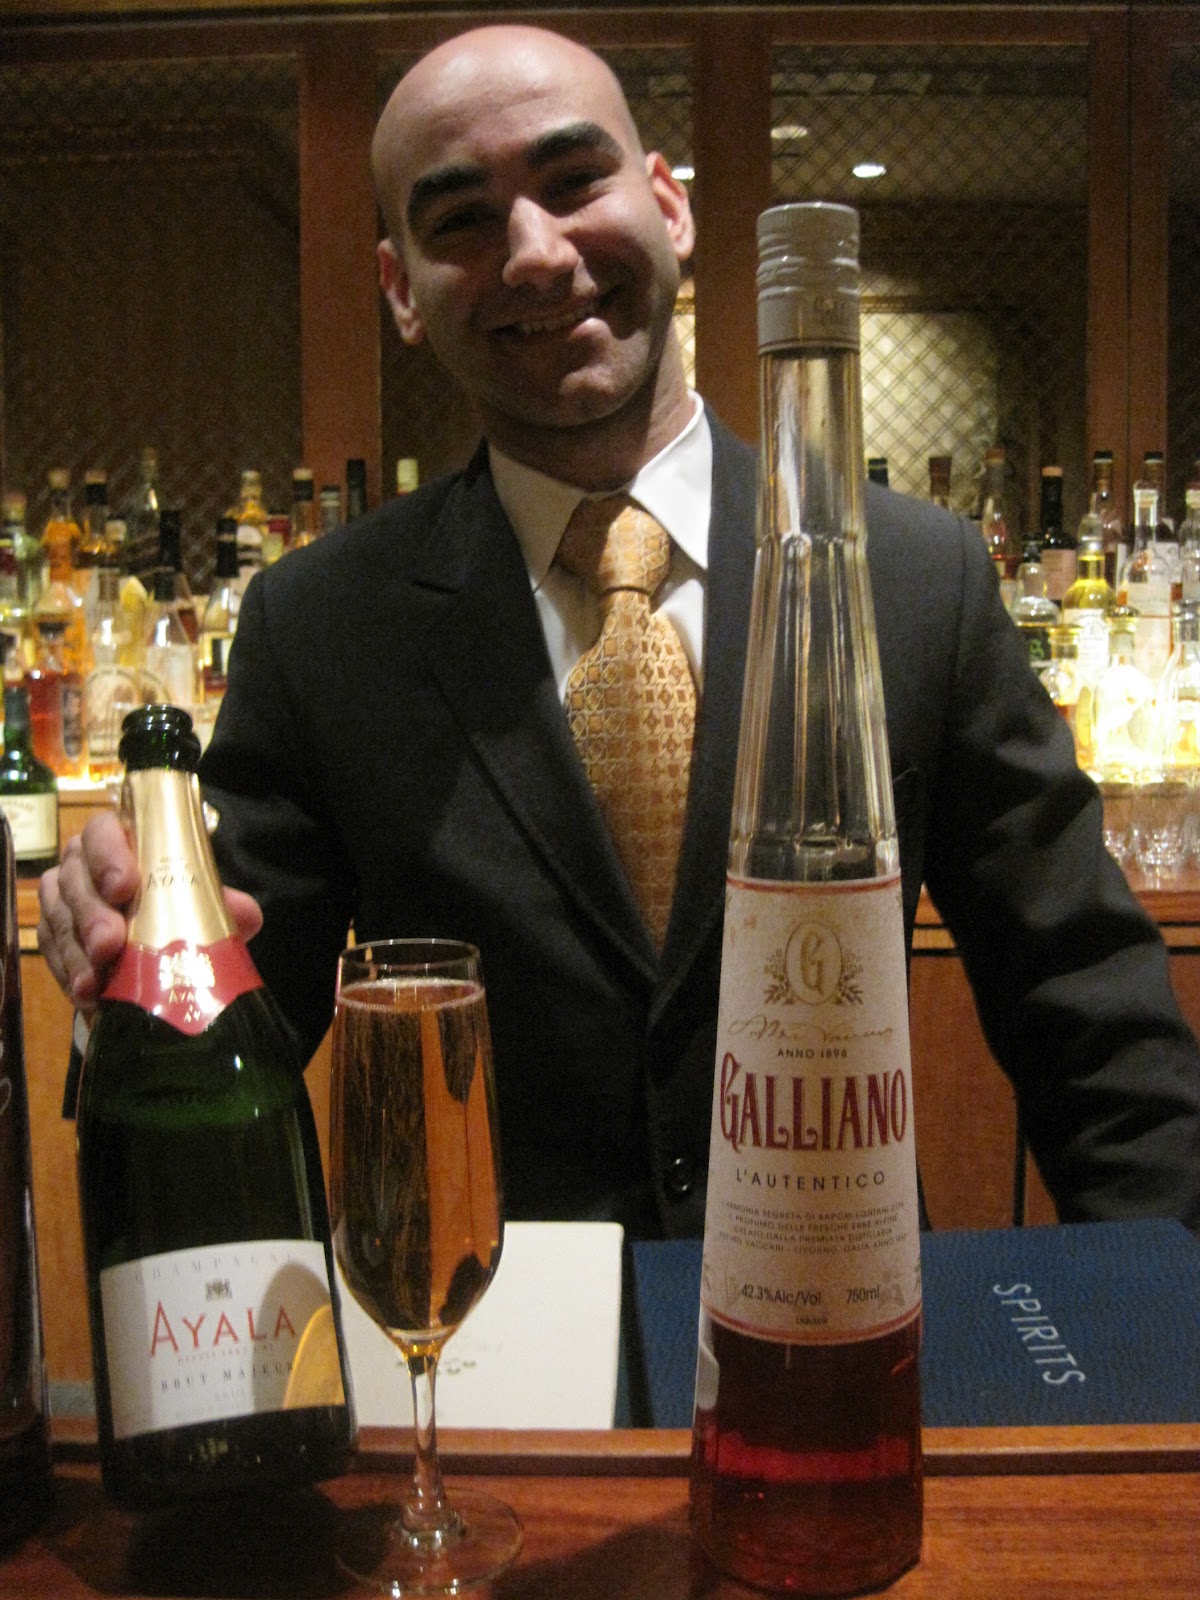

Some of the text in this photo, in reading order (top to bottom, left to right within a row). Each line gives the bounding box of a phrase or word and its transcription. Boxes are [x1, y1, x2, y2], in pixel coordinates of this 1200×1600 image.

[777, 1049, 815, 1059] ANNO
[720, 1052, 907, 1153] GALLIANO
[736, 1168, 886, 1191] L'AUTENTICO
[847, 1285, 881, 1305] 750ml
[151, 1300, 297, 1357] AYALA
[992, 1283, 1086, 1384] SPIRITS
